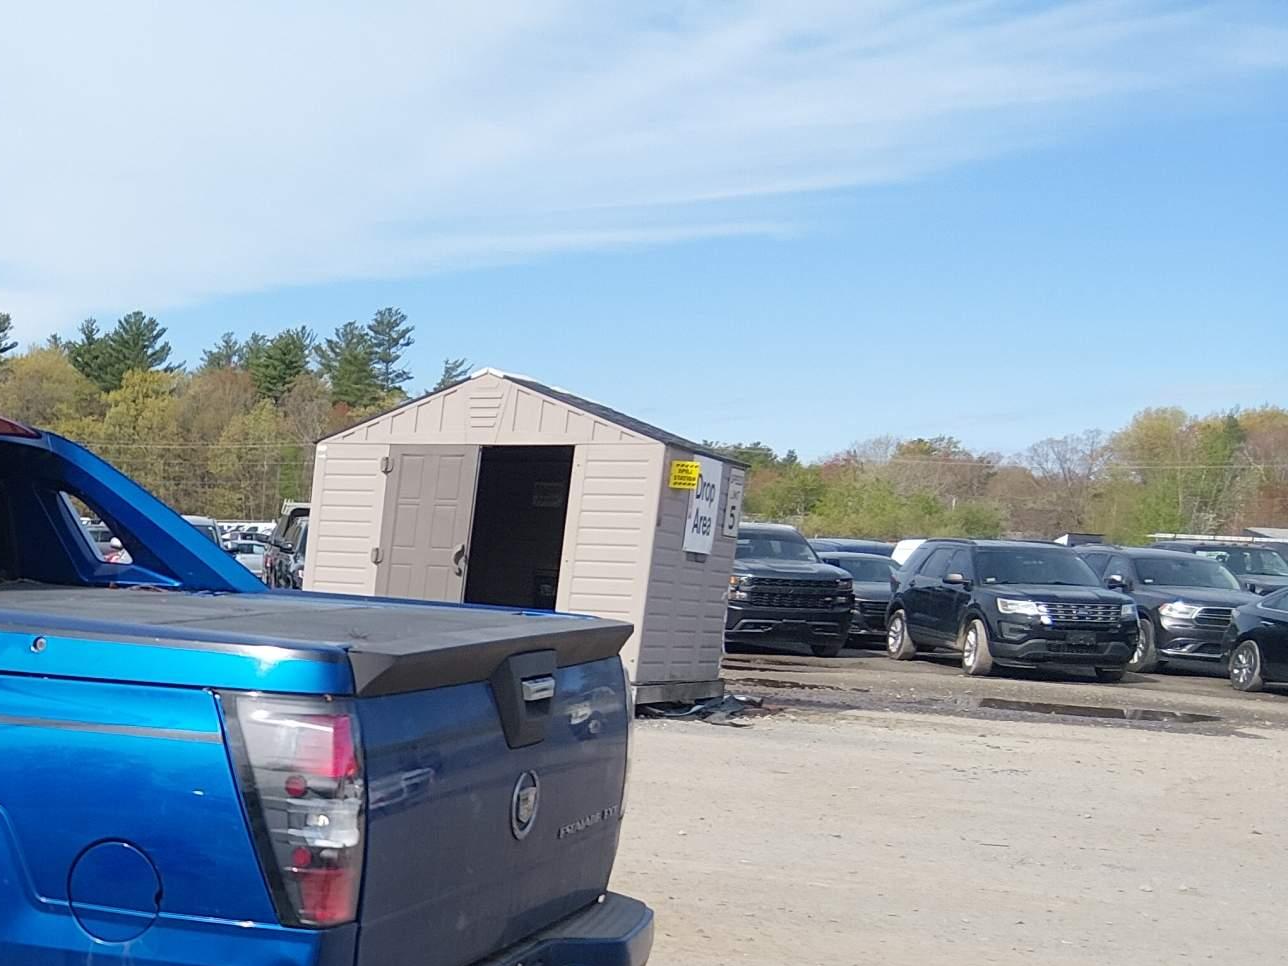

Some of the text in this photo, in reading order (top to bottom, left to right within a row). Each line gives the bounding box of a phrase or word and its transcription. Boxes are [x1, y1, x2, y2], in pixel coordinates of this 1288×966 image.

[696, 473, 716, 508] Drop
[691, 508, 711, 536] Area
[728, 505, 736, 530] 5
